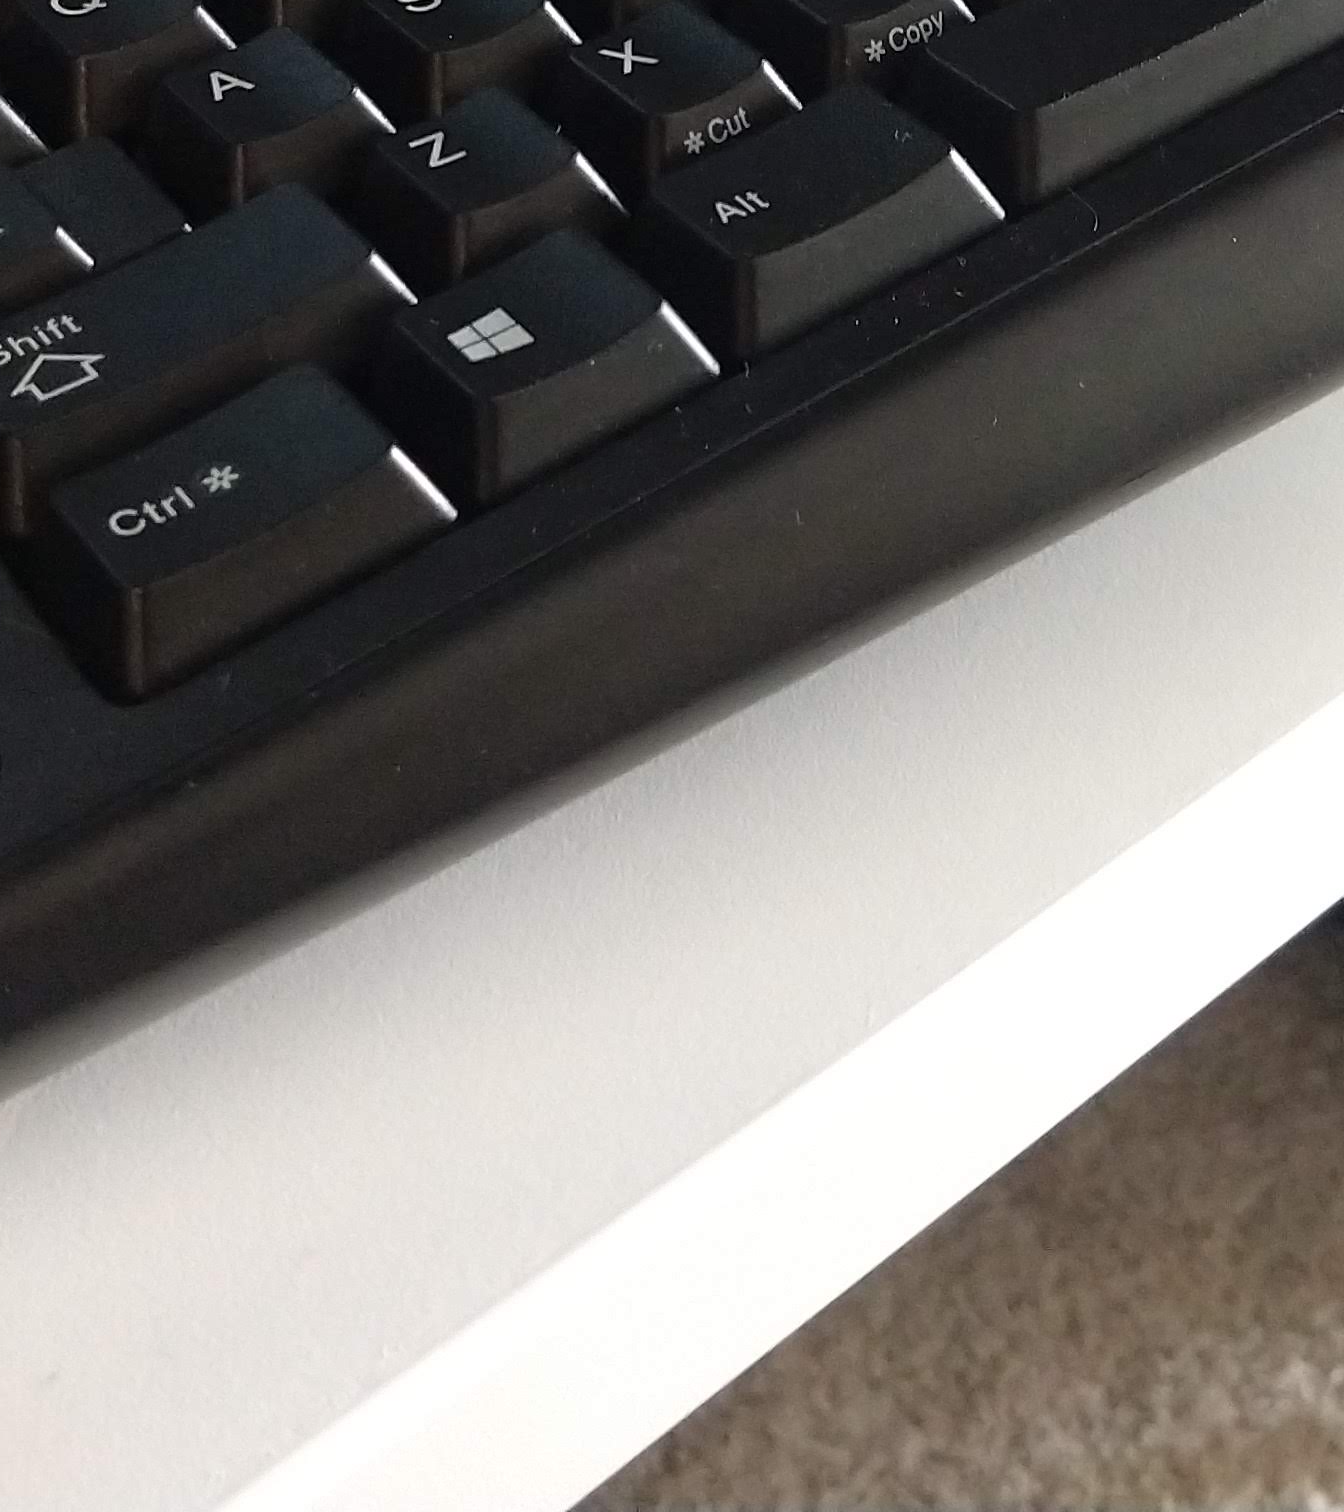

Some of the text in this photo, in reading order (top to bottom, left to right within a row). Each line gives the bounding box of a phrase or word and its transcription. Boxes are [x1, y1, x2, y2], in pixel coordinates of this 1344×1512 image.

[597, 37, 660, 76] X
[207, 70, 256, 103] A
[408, 130, 469, 169] Z
[713, 189, 772, 226] Alt
[107, 485, 197, 538] Ctrl
